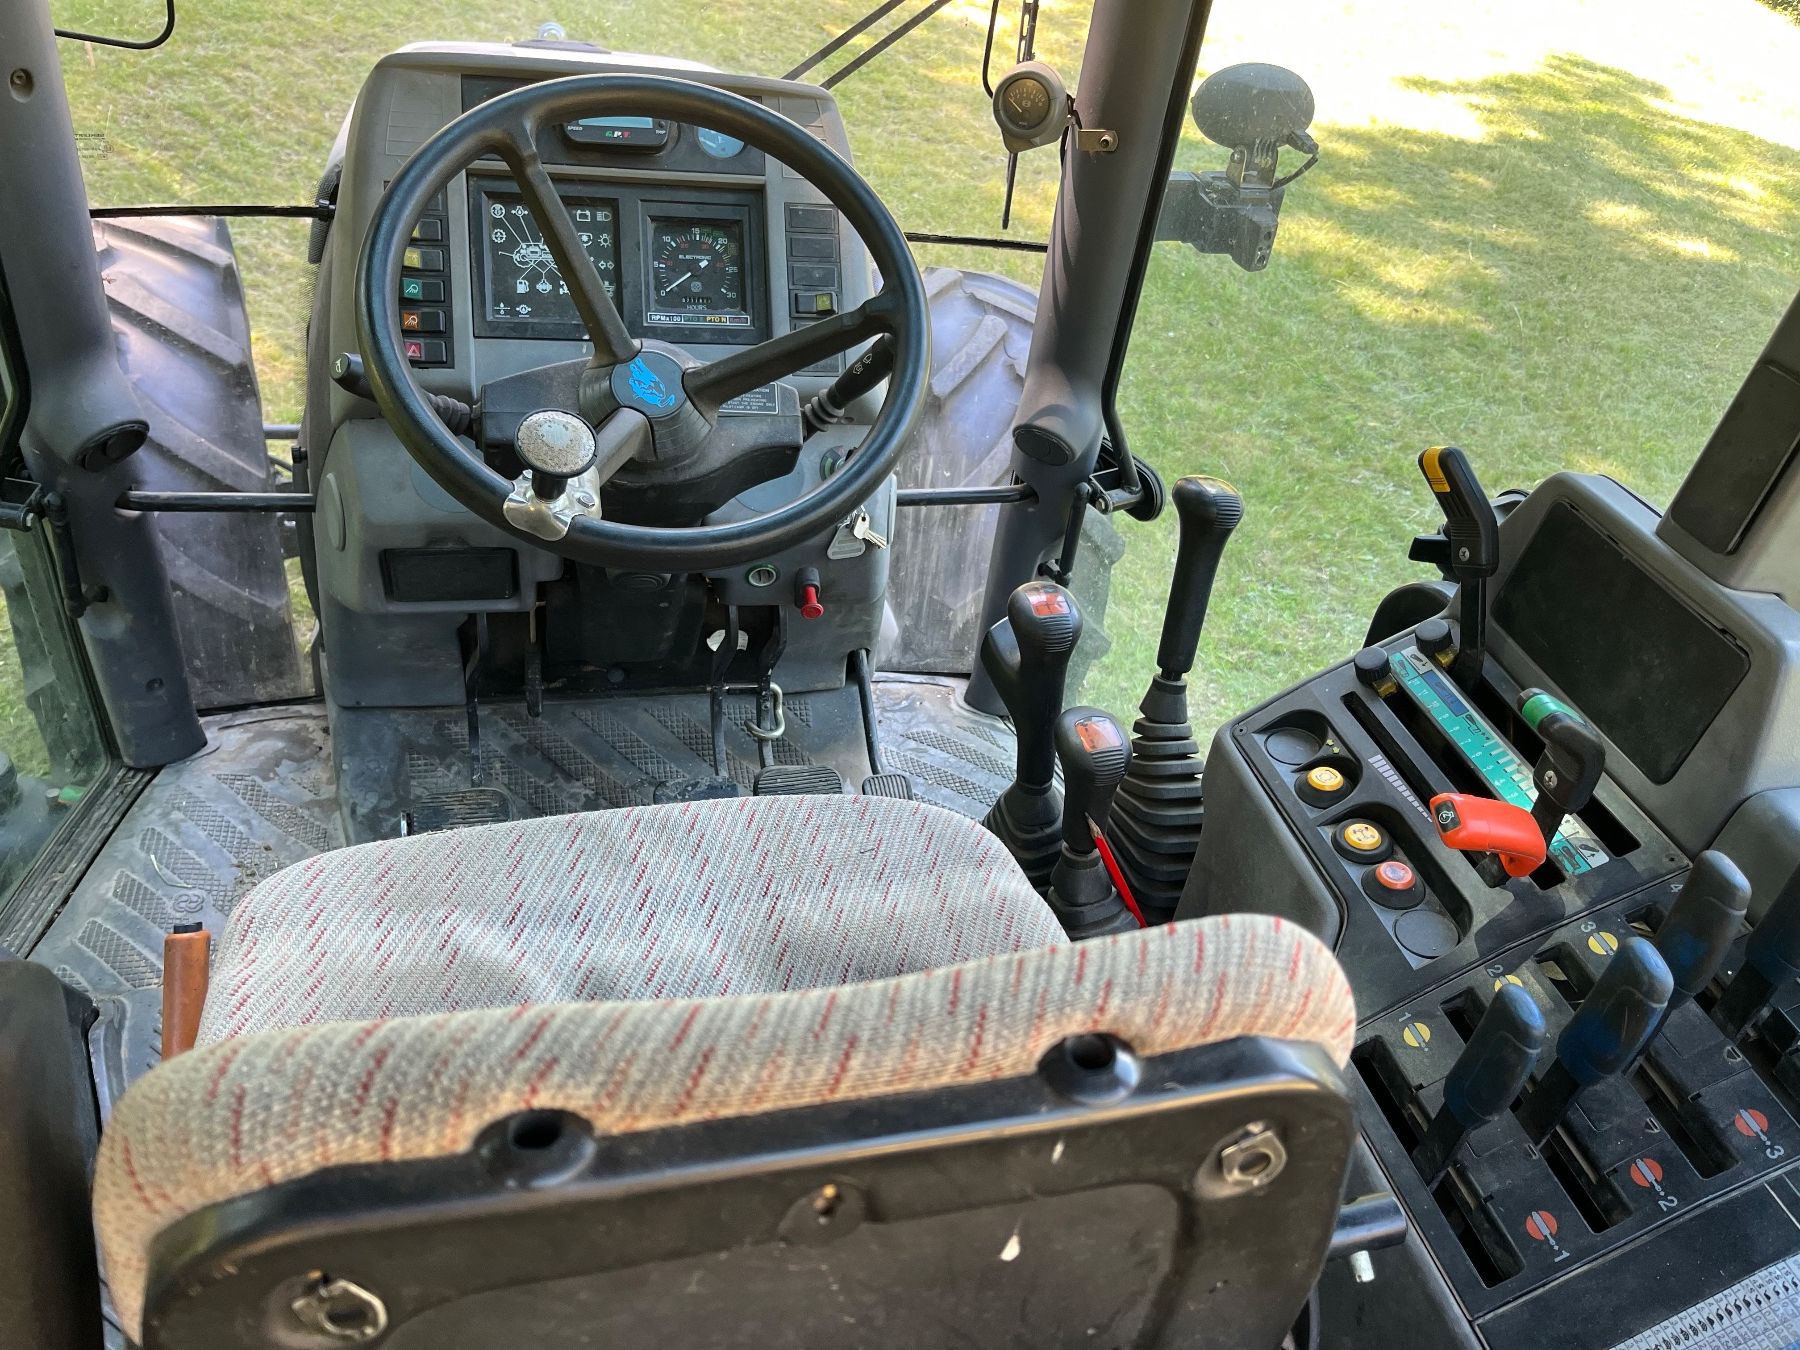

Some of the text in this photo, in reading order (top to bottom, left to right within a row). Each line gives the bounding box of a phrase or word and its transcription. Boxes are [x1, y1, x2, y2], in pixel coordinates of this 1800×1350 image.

[1670, 882, 1684, 893] 4
[1580, 920, 1597, 934] 3
[1485, 964, 1505, 978] 2
[1398, 1012, 1412, 1023] 1
[1765, 1145, 1785, 1160] 3
[1657, 1195, 1678, 1211] 2
[1554, 1249, 1571, 1262] 1
